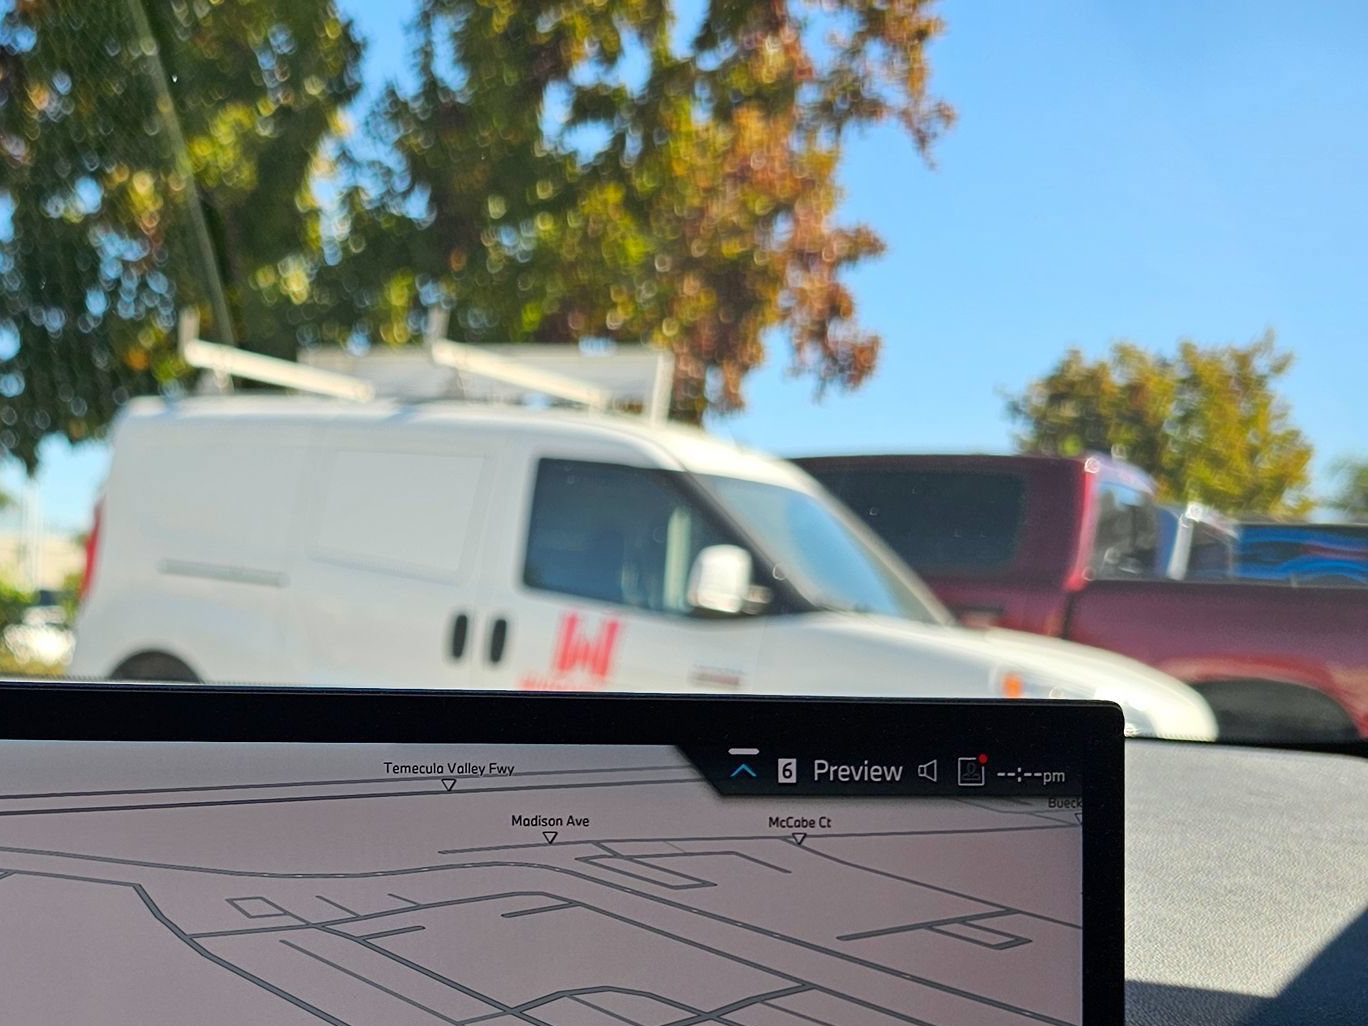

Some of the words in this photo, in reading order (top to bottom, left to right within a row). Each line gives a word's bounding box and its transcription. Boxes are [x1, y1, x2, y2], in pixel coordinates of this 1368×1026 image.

[383, 761, 444, 775] Temecula
[446, 762, 486, 776] Valley
[488, 762, 515, 777] Fwy
[813, 759, 904, 782] Preview
[511, 814, 563, 827] Madison
[566, 814, 590, 827] Ave
[768, 816, 816, 829] McCabe
[818, 816, 832, 829] Ct
